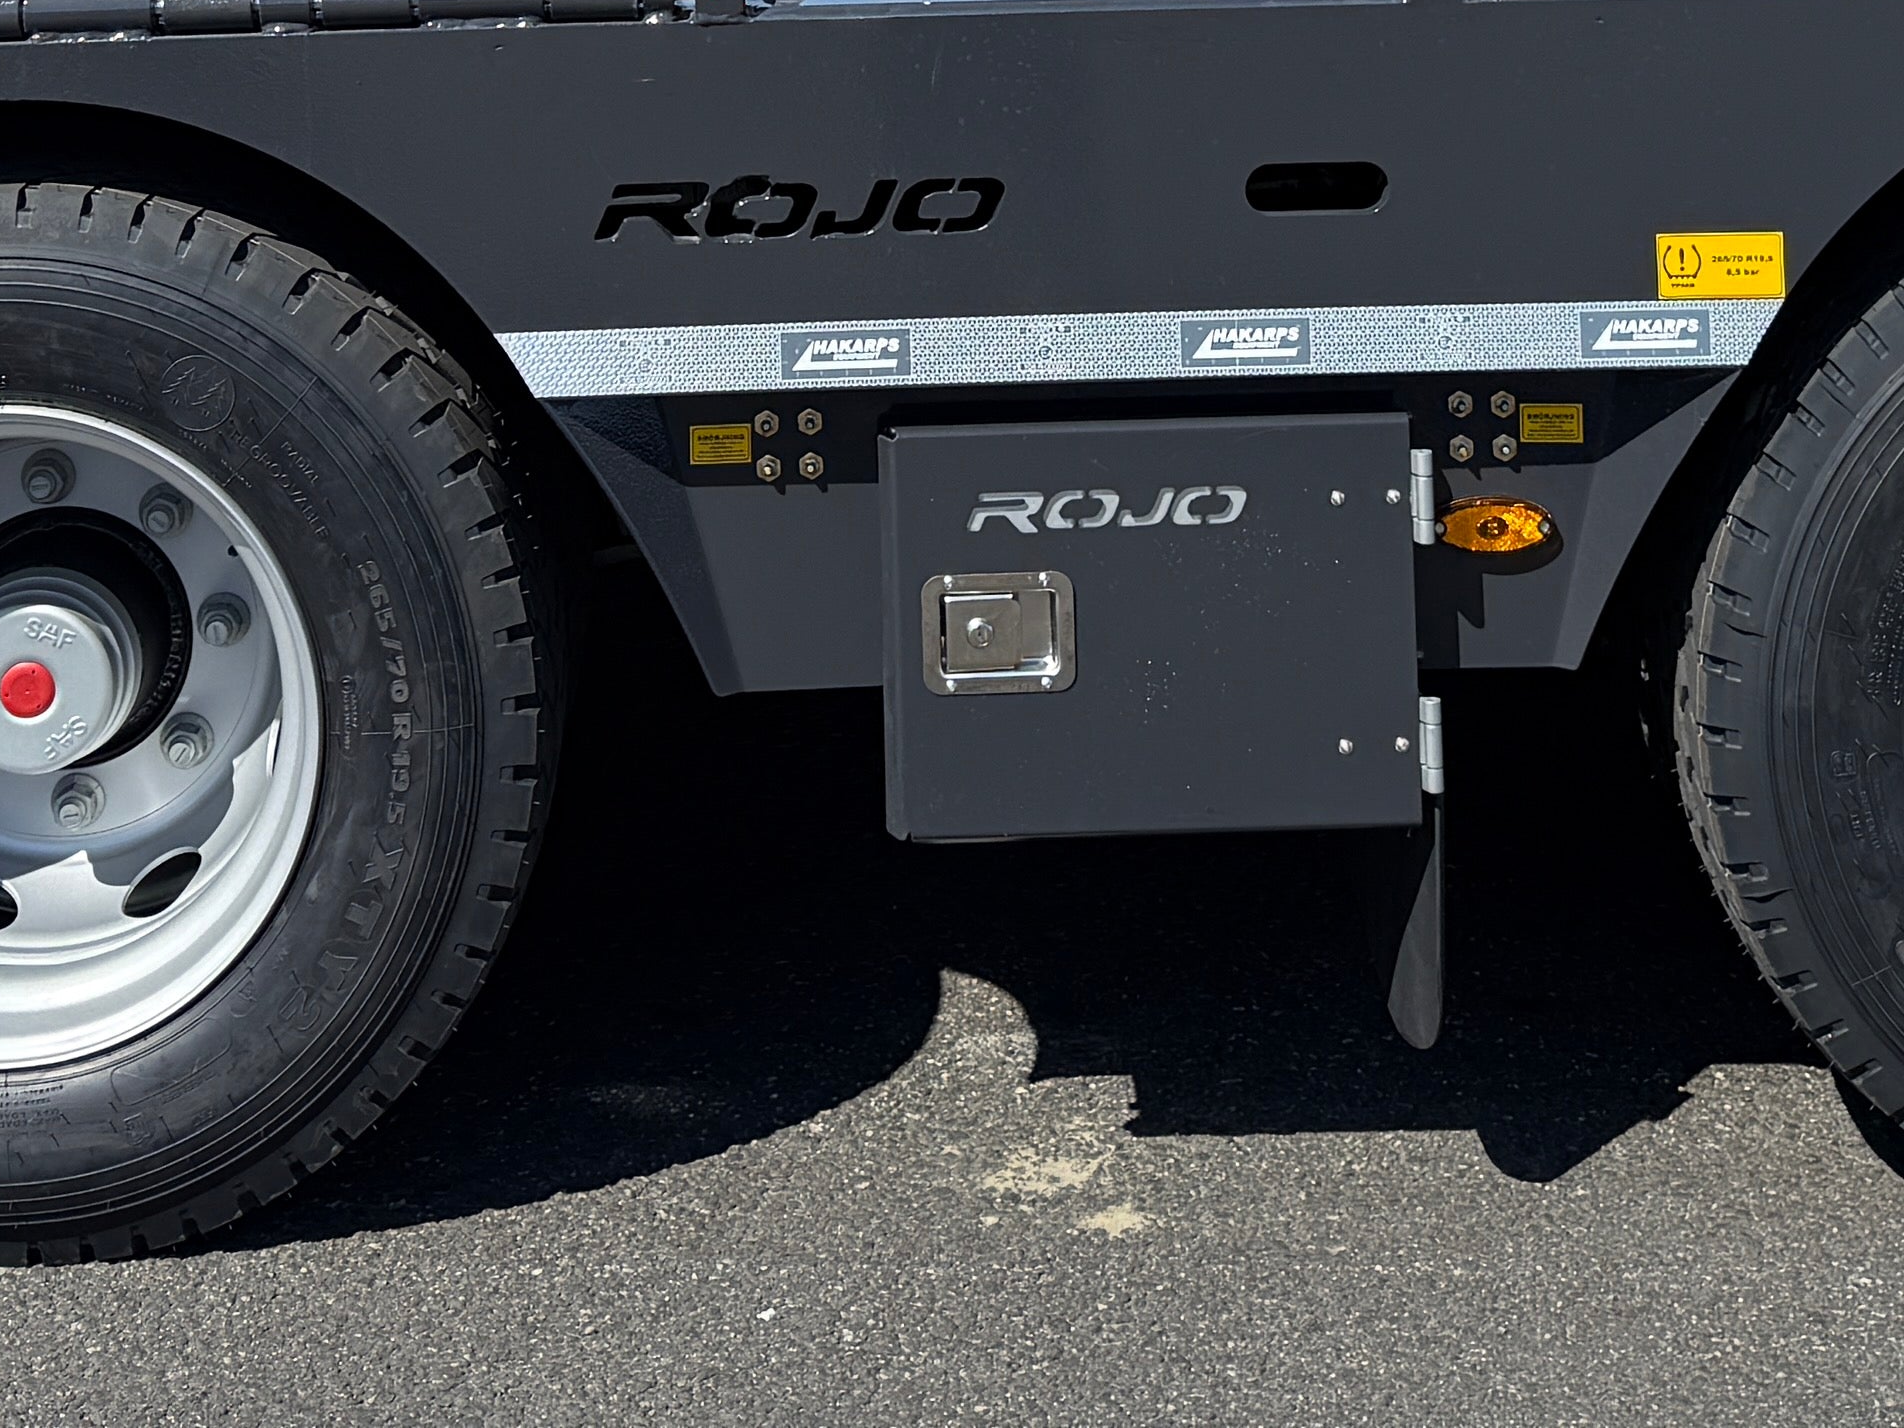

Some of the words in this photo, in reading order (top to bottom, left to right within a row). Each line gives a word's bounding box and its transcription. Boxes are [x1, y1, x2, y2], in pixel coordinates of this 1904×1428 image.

[593, 174, 1007, 244] ROJO
[1213, 326, 1301, 343] HAKARPS
[1611, 317, 1700, 334] HAKARPS
[812, 336, 901, 355] HAKARPS
[966, 484, 1248, 534] ROJO
[23, 616, 78, 648] SAF
[352, 554, 414, 704] 265/70
[43, 715, 88, 761] SAF
